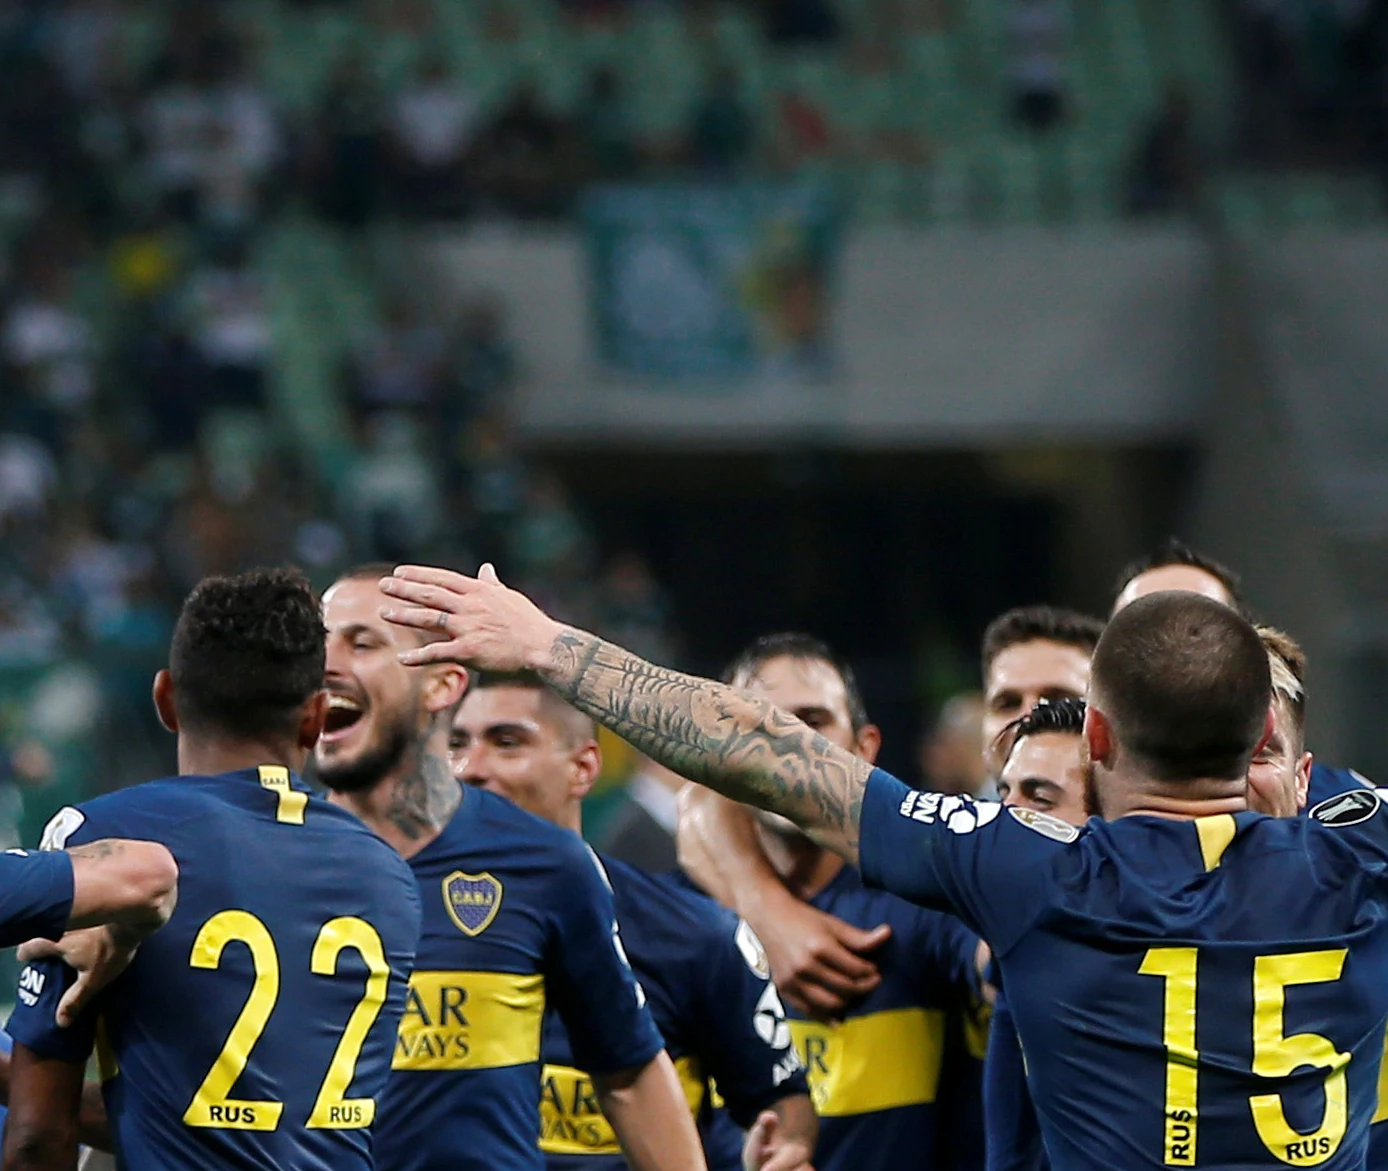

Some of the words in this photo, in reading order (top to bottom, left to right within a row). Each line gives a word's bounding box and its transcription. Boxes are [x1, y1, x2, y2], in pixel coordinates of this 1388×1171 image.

[182, 908, 389, 1132] 22
[1137, 946, 1352, 1167] 15
[209, 1106, 255, 1124] RUS
[329, 1106, 362, 1123] RUS
[1171, 1108, 1191, 1160] RUS
[1285, 1137, 1331, 1161] RUS
